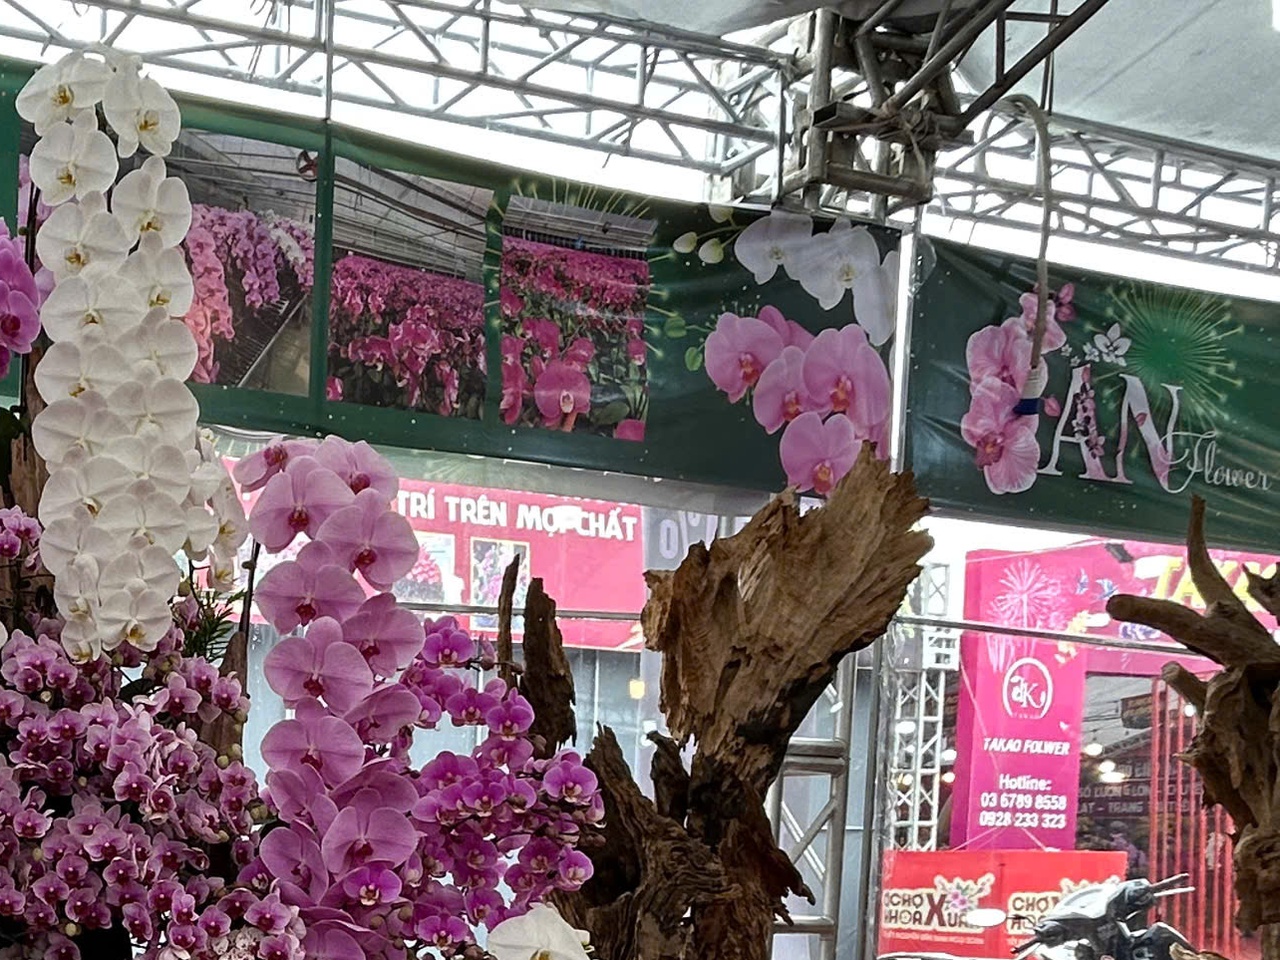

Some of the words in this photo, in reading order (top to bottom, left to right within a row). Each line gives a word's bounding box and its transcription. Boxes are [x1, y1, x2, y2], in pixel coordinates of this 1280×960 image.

[1158, 430, 1272, 494] Flower
[397, 488, 435, 519] TRÍ
[444, 494, 508, 528] TRÊN
[516, 505, 571, 538] MỌ
[983, 737, 1023, 753] TAKAO
[999, 774, 1052, 791] Hotline:
[980, 792, 998, 808] 03
[1014, 812, 1039, 828] 233
[1041, 813, 1067, 829] 323
